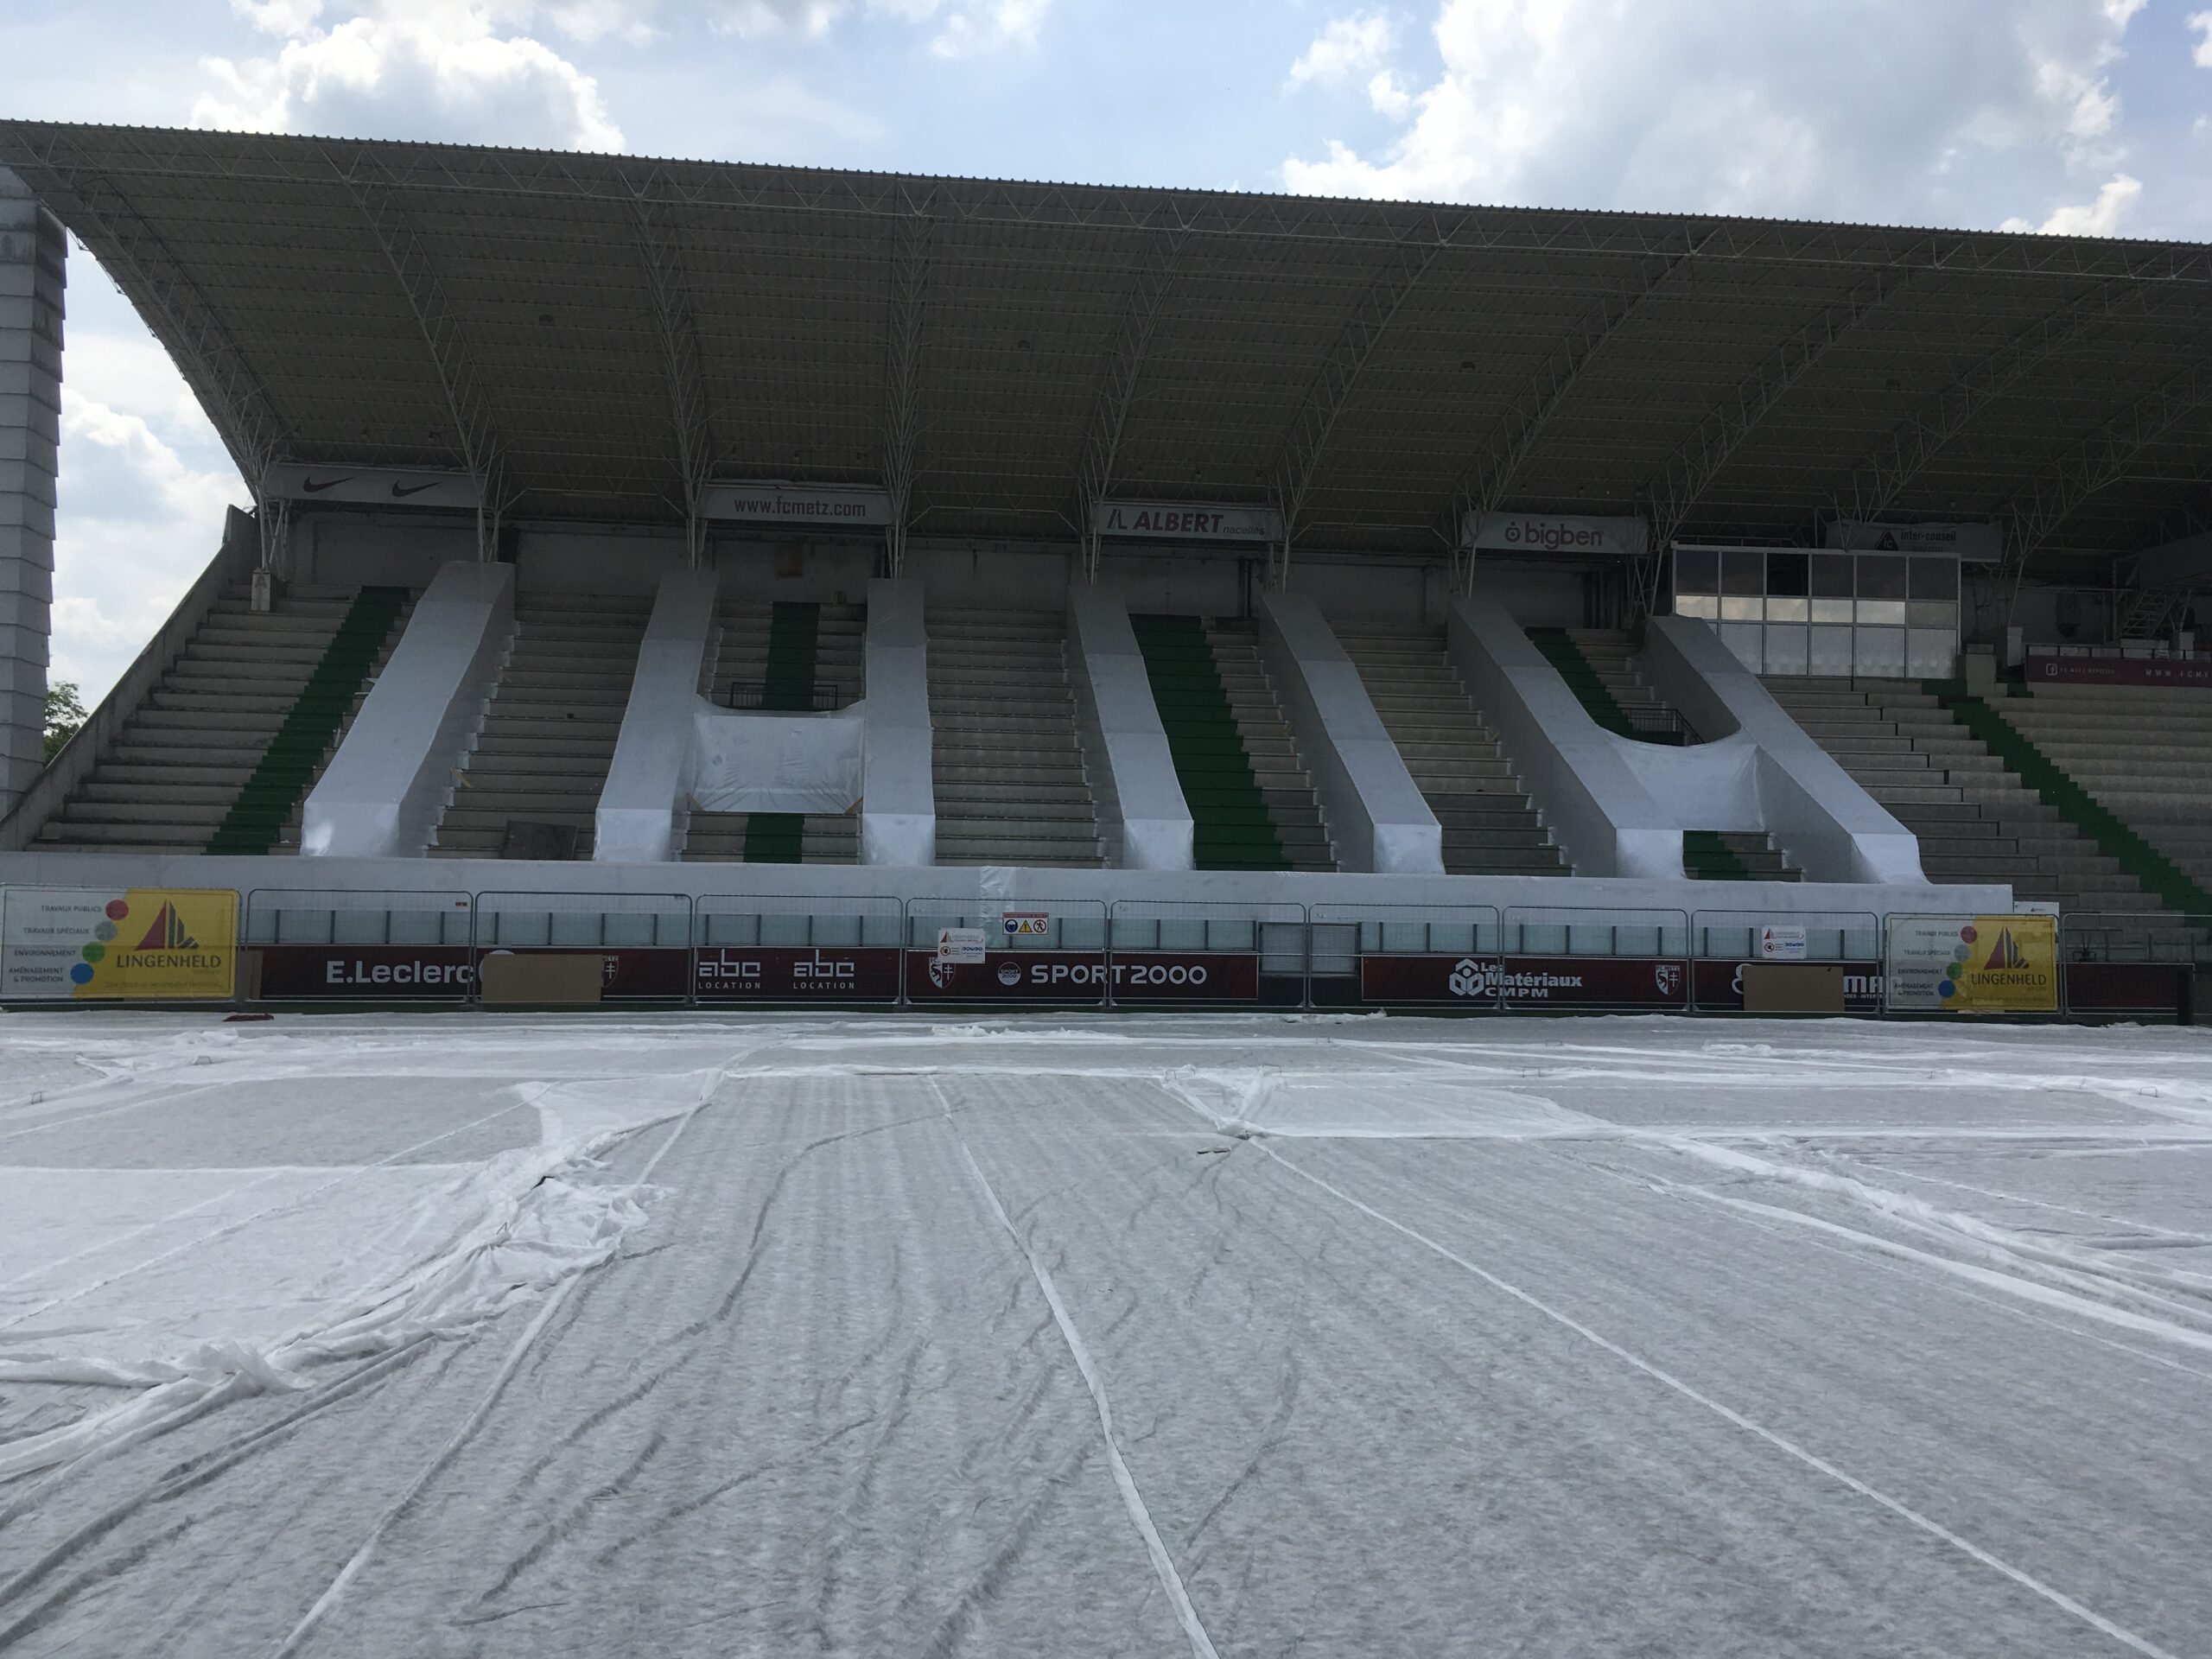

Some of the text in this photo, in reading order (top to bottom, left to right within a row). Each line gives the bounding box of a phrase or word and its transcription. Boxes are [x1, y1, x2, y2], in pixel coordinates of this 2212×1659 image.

[734, 496, 866, 517] www.fcmetz.com
[1133, 512, 1265, 536] ALBERT nacelles
[1901, 528, 1956, 541] inter-conseil
[1525, 522, 1602, 550] bigben
[117, 955, 221, 968] LINGENHELD
[326, 960, 474, 984] E.Leclerc
[699, 948, 760, 977] abc
[793, 949, 855, 977] abc
[1480, 962, 1503, 972] Les
[1030, 964, 1207, 985] SPORT 2000
[1484, 971, 1582, 988] Matériaux
[1971, 974, 2046, 986] LINGENHELD
[1484, 988, 1548, 997] CMPM
